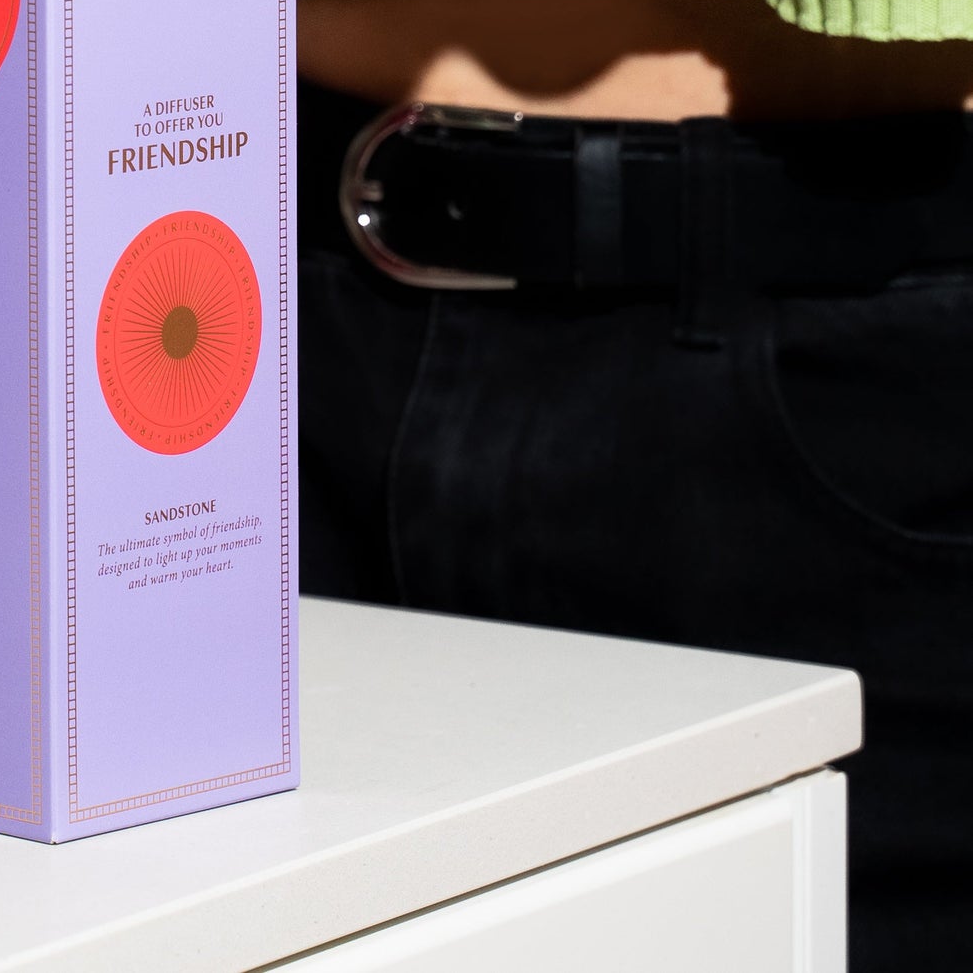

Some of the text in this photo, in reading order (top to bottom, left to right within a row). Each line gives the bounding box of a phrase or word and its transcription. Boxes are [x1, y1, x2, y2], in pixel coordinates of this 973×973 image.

[134, 112, 224, 138] TO OFFER YOU
[143, 95, 215, 117] A DIFFUSER
[108, 131, 249, 175] FRIENDSHIP
[163, 220, 235, 256] FRIENDSHIP
[103, 235, 152, 335] FRIENDSHIP
[239, 266, 254, 377] FRIENDSHIP
[102, 357, 154, 445] FRIENDSHIP
[165, 389, 238, 445] FRIENDSHIP
[144, 499, 217, 525] SANDSTONE
[97, 514, 263, 557] The ultimate symbol of friendship,
[97, 534, 263, 577] designed to light up your moments
[128, 558, 234, 589] and warm your heart.
